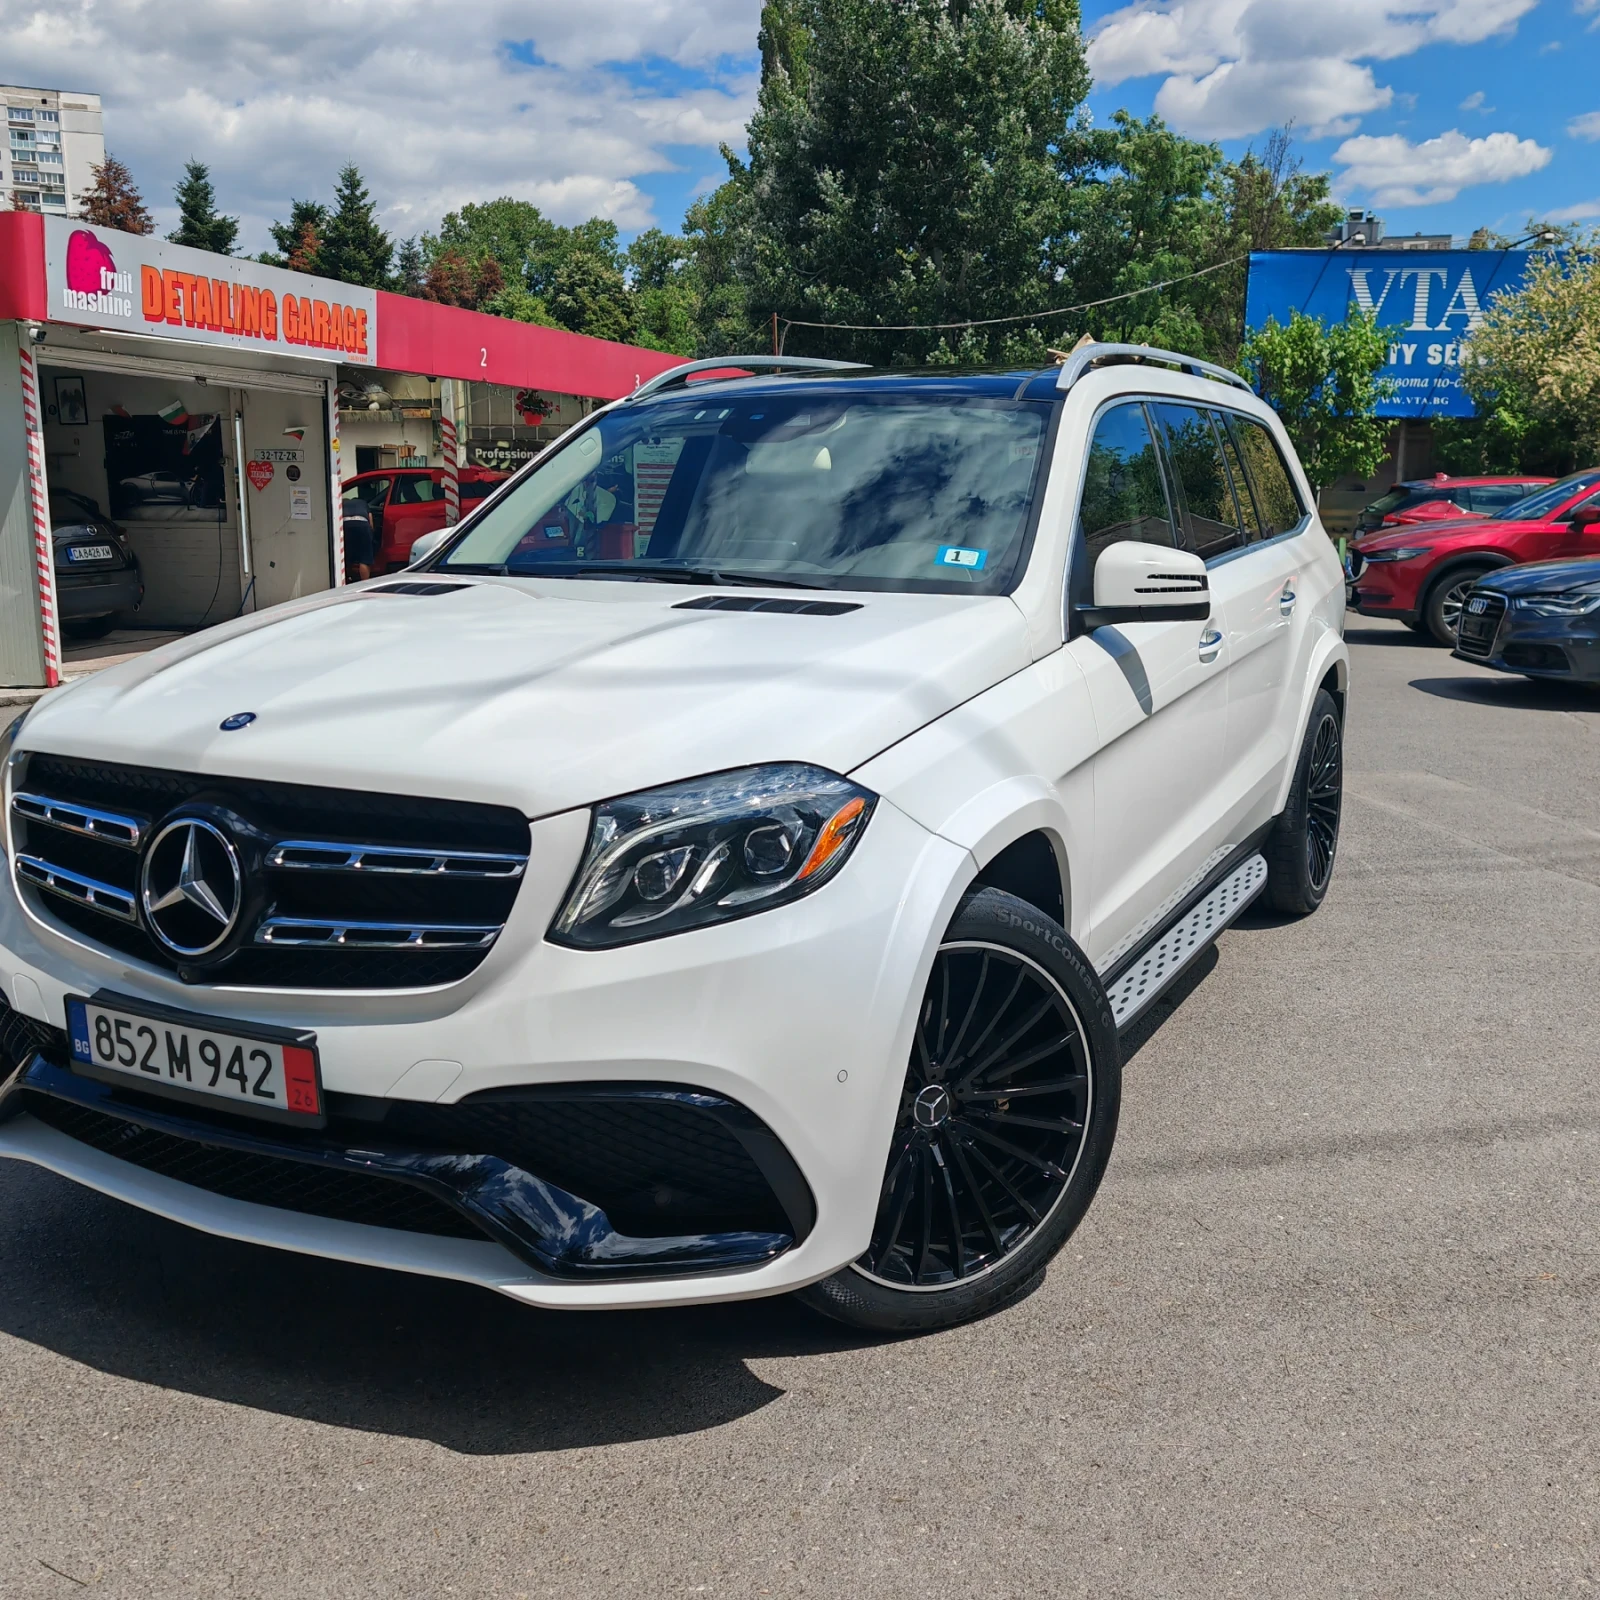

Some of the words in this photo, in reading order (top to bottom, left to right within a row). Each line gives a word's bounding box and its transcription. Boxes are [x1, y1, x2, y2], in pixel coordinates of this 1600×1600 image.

[100, 266, 133, 294] fruit
[63, 287, 132, 318] mashine
[1345, 267, 1486, 332] VTA
[141, 264, 278, 340] DETAILING
[282, 293, 368, 355] GARAGE
[480, 348, 487, 367] 2
[635, 373, 640, 390] 3
[1376, 396, 1449, 405] WW.VTA.BG
[261, 451, 298, 461] 32-TZ-ZR
[475, 448, 541, 459] Professiona
[950, 550, 961, 562] 1
[74, 1038, 90, 1054] BG
[293, 1088, 313, 1106] 26
